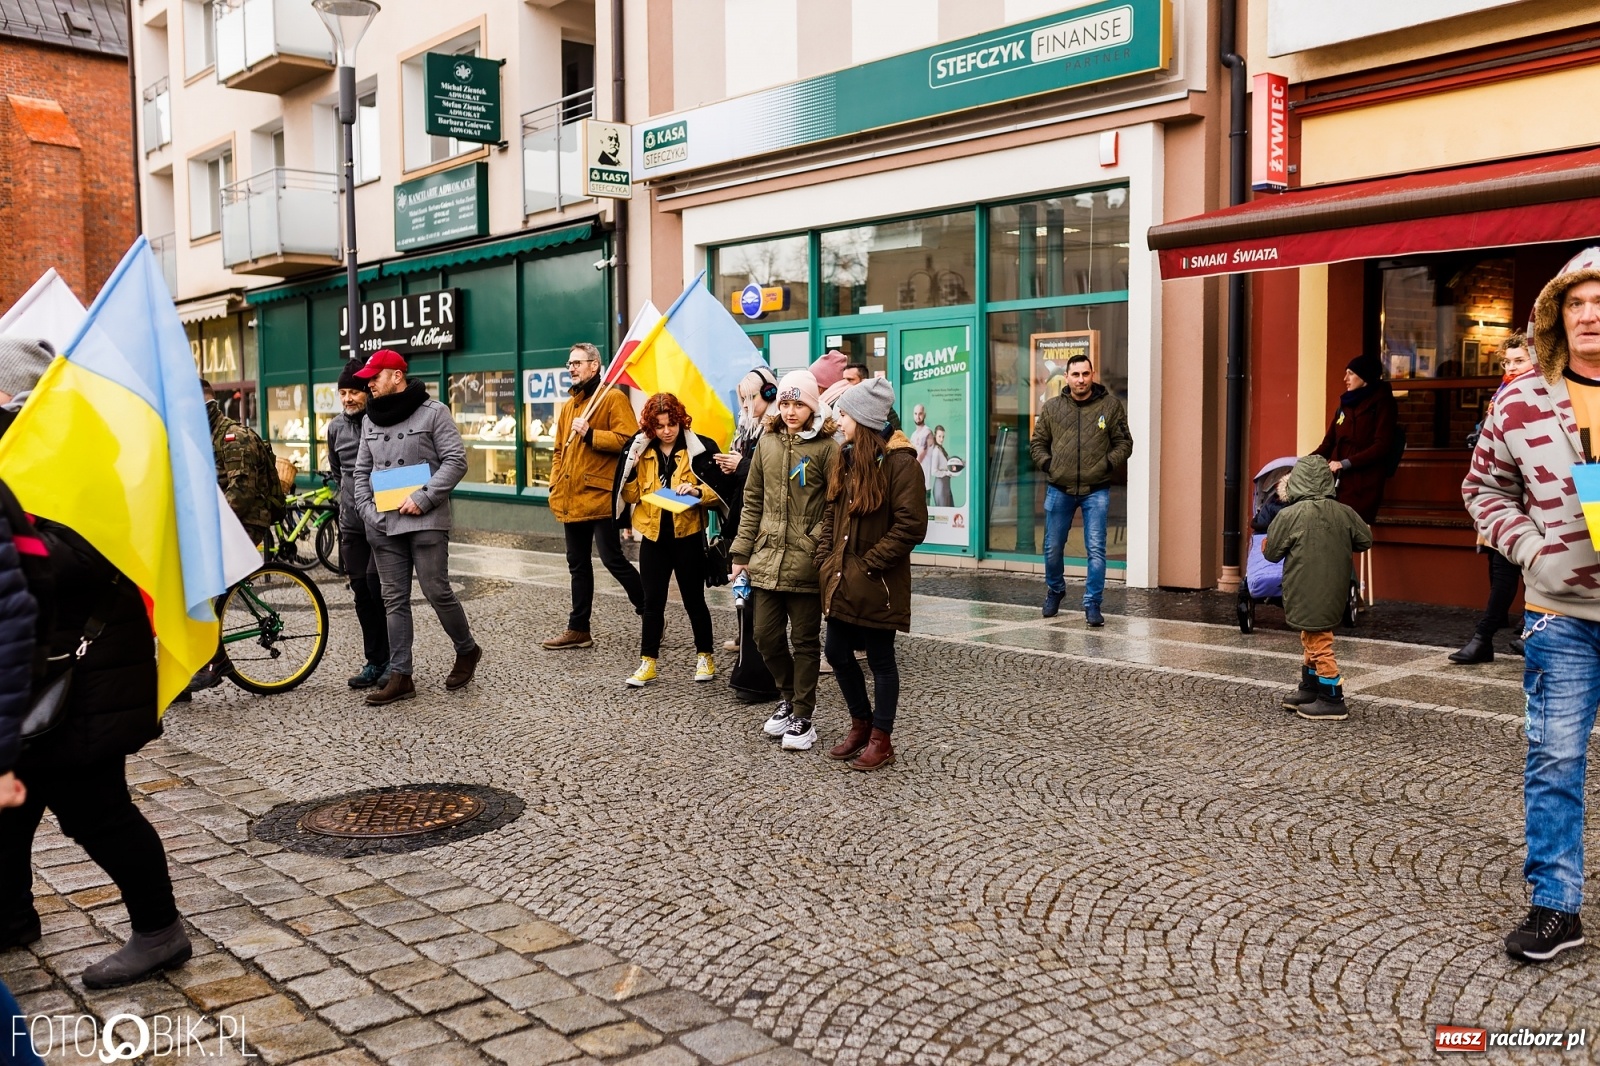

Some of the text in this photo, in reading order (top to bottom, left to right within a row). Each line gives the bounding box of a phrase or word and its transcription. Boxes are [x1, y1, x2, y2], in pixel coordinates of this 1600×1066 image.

[936, 17, 1122, 79] STEFCZYK FINANSE
[1065, 48, 1131, 72] PARTNER
[448, 91, 480, 101] ADWOKAT
[449, 109, 480, 119] ADWOKAT
[449, 126, 481, 136] ADWOKAT
[657, 125, 686, 144] KASA
[1269, 83, 1284, 173] ŻYWIEC
[645, 147, 686, 166] STEFCZYKA
[602, 172, 628, 183] KASY
[591, 183, 628, 194] STEFCZYKA
[1191, 247, 1279, 269] SMAKI ŚWIATA
[363, 338, 382, 351] 1989
[904, 345, 958, 372] GRAMY
[912, 360, 967, 381] ZESPOŁOWO
